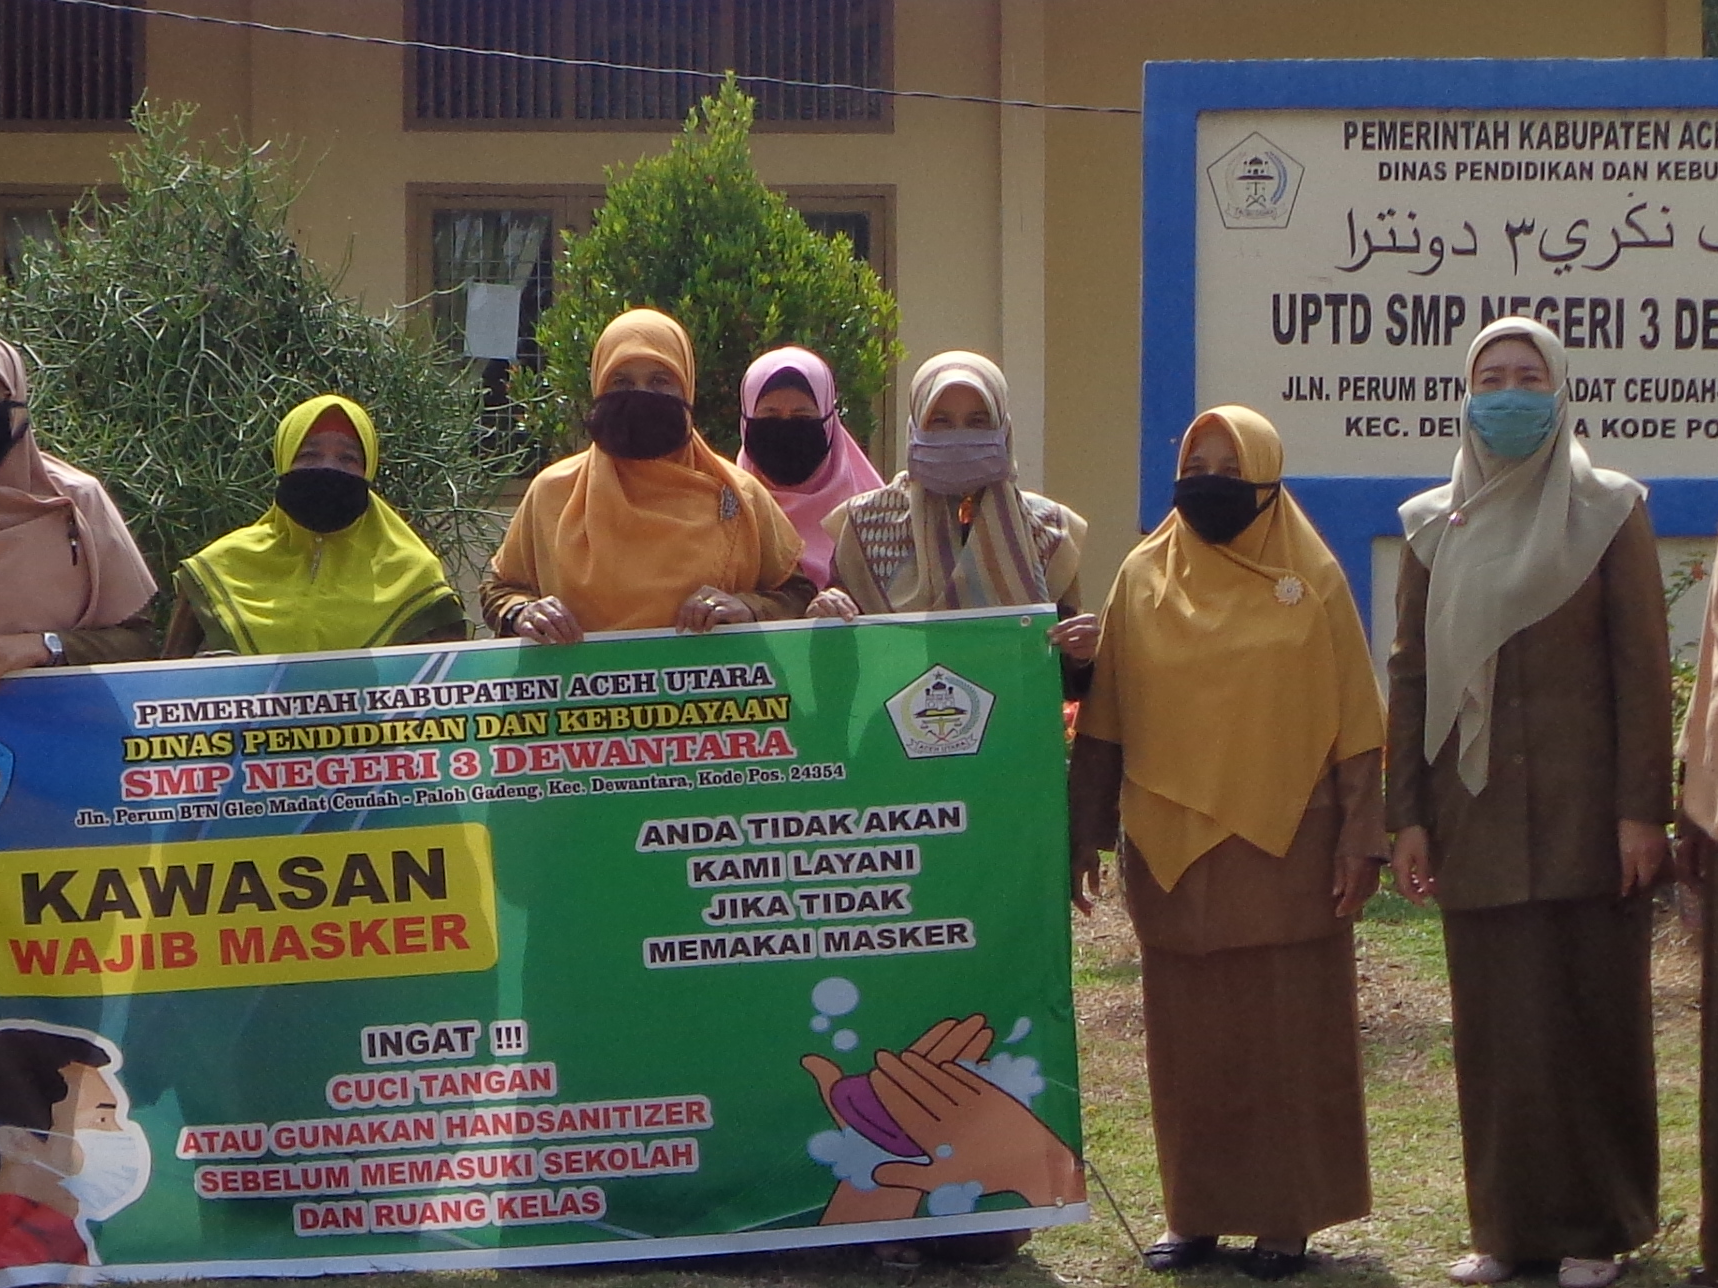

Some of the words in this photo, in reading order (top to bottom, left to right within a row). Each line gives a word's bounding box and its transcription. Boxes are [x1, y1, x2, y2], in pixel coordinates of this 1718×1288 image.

[1344, 120, 1510, 151] PEMERINTAH
[1519, 120, 1671, 151] KABUPATEN
[1378, 161, 1447, 181] DINAS
[1455, 161, 1593, 181] PENDIDIKAN
[1602, 161, 1648, 181] DAN
[1272, 293, 1372, 345] UPTD
[1385, 293, 1466, 346] SMP
[1639, 298, 1660, 349] 3
[1282, 377, 1330, 401] JLN.
[1338, 377, 1416, 401] PERUM
[1424, 377, 1467, 402] BTN
[1345, 416, 1409, 437] KEC.
[1601, 418, 1676, 439] KODE
[137, 693, 358, 726] PEMERINTAH
[367, 678, 559, 711] KABUPATEN
[568, 672, 656, 698] ACEH
[665, 665, 773, 692] UTARA
[124, 731, 233, 761] DINAS
[243, 717, 466, 754] PENDIDIKAN
[477, 712, 546, 739] DAN
[558, 696, 789, 734] KEBUDAYAAN
[123, 765, 230, 798] SMP
[245, 751, 438, 790] NEGERI
[452, 751, 477, 777] 3
[493, 730, 793, 774] DEWANTARA
[77, 810, 110, 826] Jln.
[115, 809, 173, 824] Perum
[183, 804, 219, 819] BTN
[224, 800, 264, 816] Glee
[269, 796, 327, 814] Madat
[333, 792, 399, 810] Ceudah
[415, 788, 465, 805] Paloh
[472, 785, 543, 800] Gadeng,
[548, 780, 585, 795] Kec.
[592, 773, 693, 793] Dewantara,
[698, 769, 743, 786] Kode
[749, 767, 785, 782] Pos.
[790, 764, 845, 780] 24354
[641, 820, 738, 847] ANDA
[747, 812, 854, 840] TIDAK
[863, 806, 961, 834] AKAN
[693, 856, 781, 882] KAMI
[793, 848, 915, 877] LAYANI
[20, 847, 447, 925] KAWASAN
[708, 895, 791, 920] JIKA
[799, 888, 905, 915] TIDAK
[8, 930, 199, 975] WAJIB
[219, 913, 471, 966] MASKER
[648, 932, 812, 964] MEMAKAI
[823, 922, 970, 953] MASKER
[367, 1026, 476, 1058] INGAT
[495, 1025, 523, 1050] !!!
[332, 1076, 408, 1104] CUCI
[419, 1067, 552, 1098] TANGAN
[182, 1128, 263, 1154] ATAU
[274, 1117, 435, 1150] GUNAKAN
[445, 1100, 708, 1139] HANDSANITIZER
[200, 1165, 350, 1193] SEBELUM
[360, 1154, 533, 1187] MEMASUKI
[543, 1143, 693, 1175] SEKOLAH
[299, 1206, 364, 1230] DAN
[374, 1198, 486, 1226] RUANG
[497, 1191, 601, 1220] KELAS
